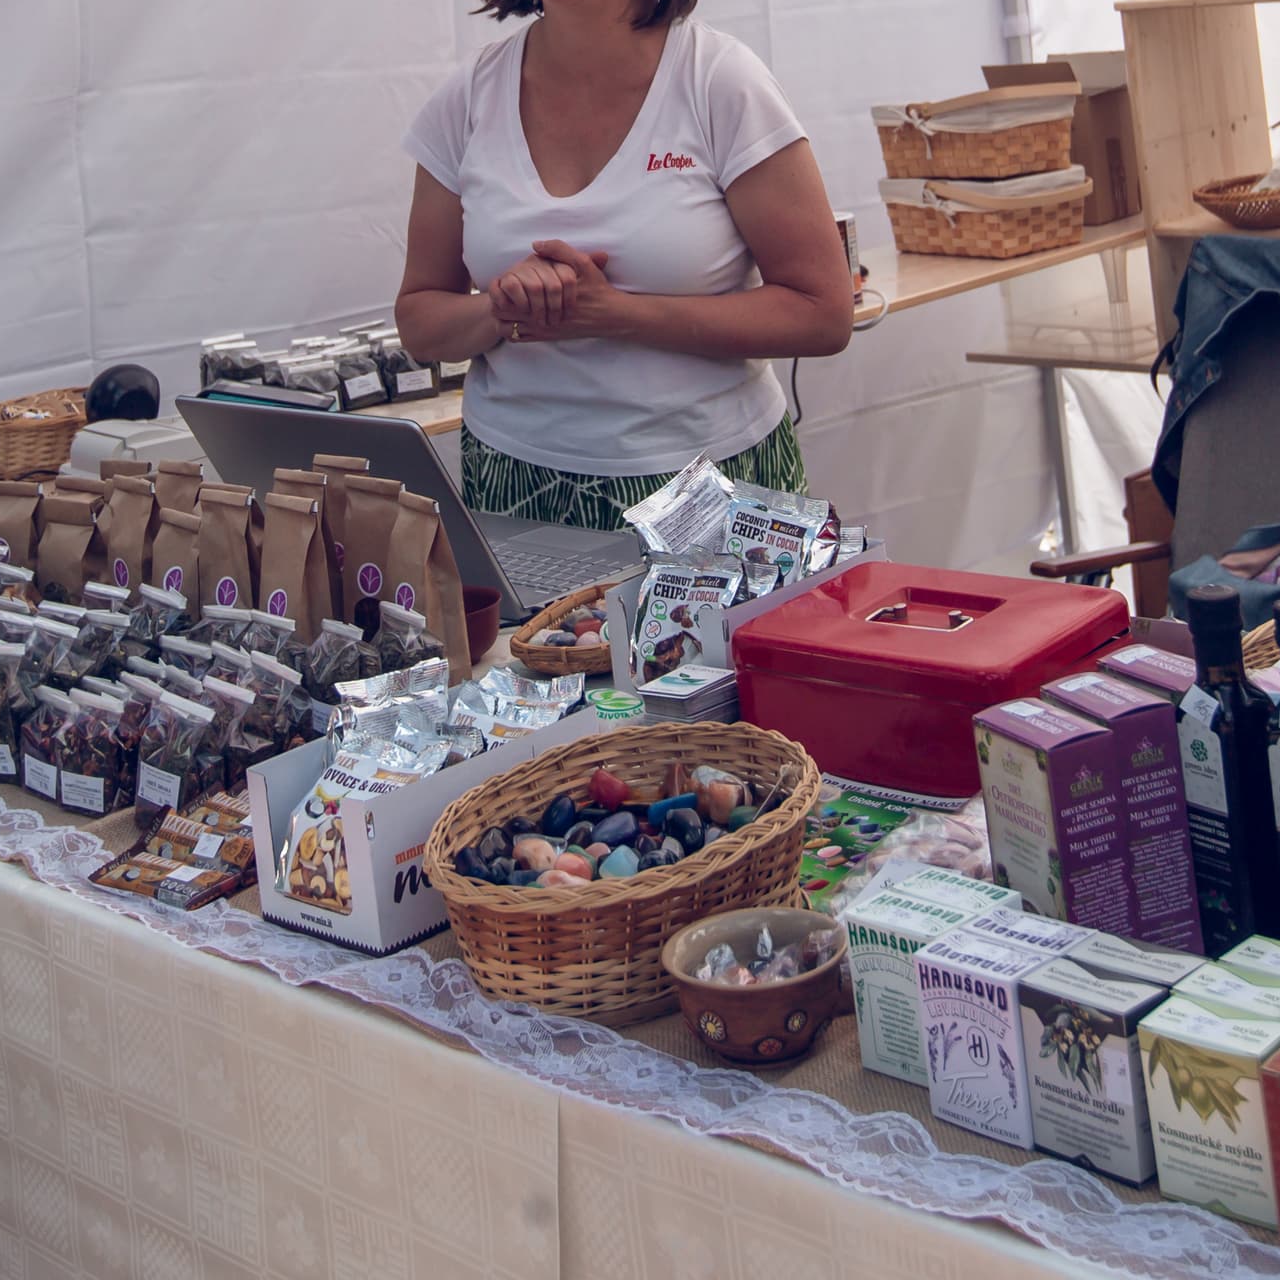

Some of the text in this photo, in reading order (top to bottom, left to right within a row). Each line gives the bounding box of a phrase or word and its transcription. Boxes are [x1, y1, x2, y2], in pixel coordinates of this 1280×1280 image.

[646, 152, 697, 172] Lee Cooper
[735, 510, 770, 528] COCONUT
[731, 521, 799, 551] CHIPS IN COCOA
[653, 582, 688, 601] CHIPS
[695, 590, 720, 603] COCOA
[656, 573, 693, 586] COCONUT
[323, 767, 370, 792] OVOCE &
[822, 777, 919, 804] DRAHÉ KAMENY
[918, 870, 1009, 901] HANUŠOVO
[871, 893, 965, 924] HANUŠOVO
[918, 963, 1008, 1011] HANUŠOVO
[1034, 1074, 1090, 1104] Kosmetické
[1092, 1098, 1125, 1116] mýdlo
[1158, 1121, 1222, 1151] Kosmetické
[1224, 1144, 1263, 1161] mýdlo
